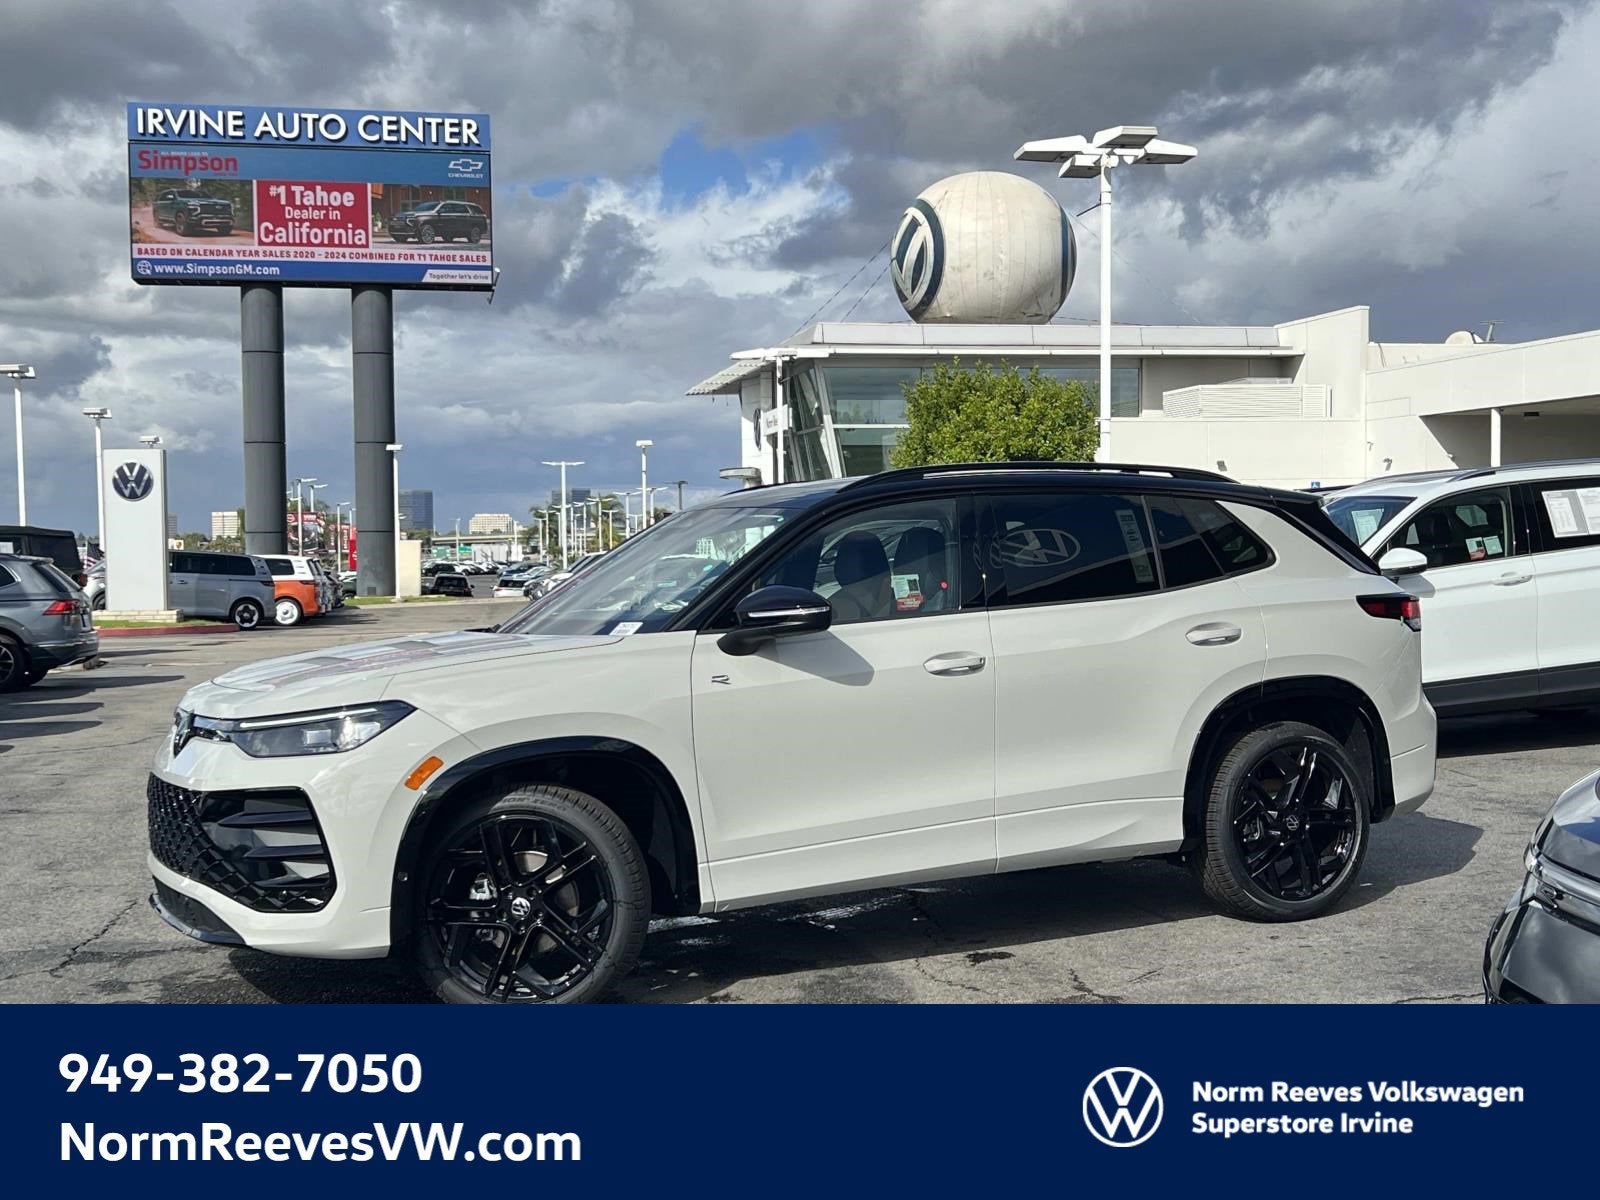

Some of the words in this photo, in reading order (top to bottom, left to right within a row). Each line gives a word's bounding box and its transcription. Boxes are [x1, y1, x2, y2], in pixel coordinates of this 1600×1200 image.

[137, 107, 245, 137] IRVINE
[254, 111, 347, 140] AUTO
[358, 115, 480, 146] CENTER
[138, 150, 238, 175] Simpson
[269, 185, 287, 205] #1
[291, 185, 355, 207] Tahoe
[284, 206, 326, 220] Dealer
[328, 207, 341, 220] in
[260, 221, 367, 245] California
[137, 247, 168, 256] BASED
[170, 248, 183, 256] ON
[185, 248, 234, 257] CALENDAR
[236, 249, 260, 258] YEAR
[262, 250, 291, 259] SALES
[294, 251, 315, 259] 2020
[325, 251, 347, 260] 2024
[349, 252, 395, 261] COMBINED
[399, 253, 415, 261] FOR
[417, 253, 427, 262] T1
[429, 254, 457, 263] TAHOE
[459, 254, 487, 263] SALES
[154, 262, 280, 276] www.SimpsonGM.com
[428, 271, 458, 280] Together
